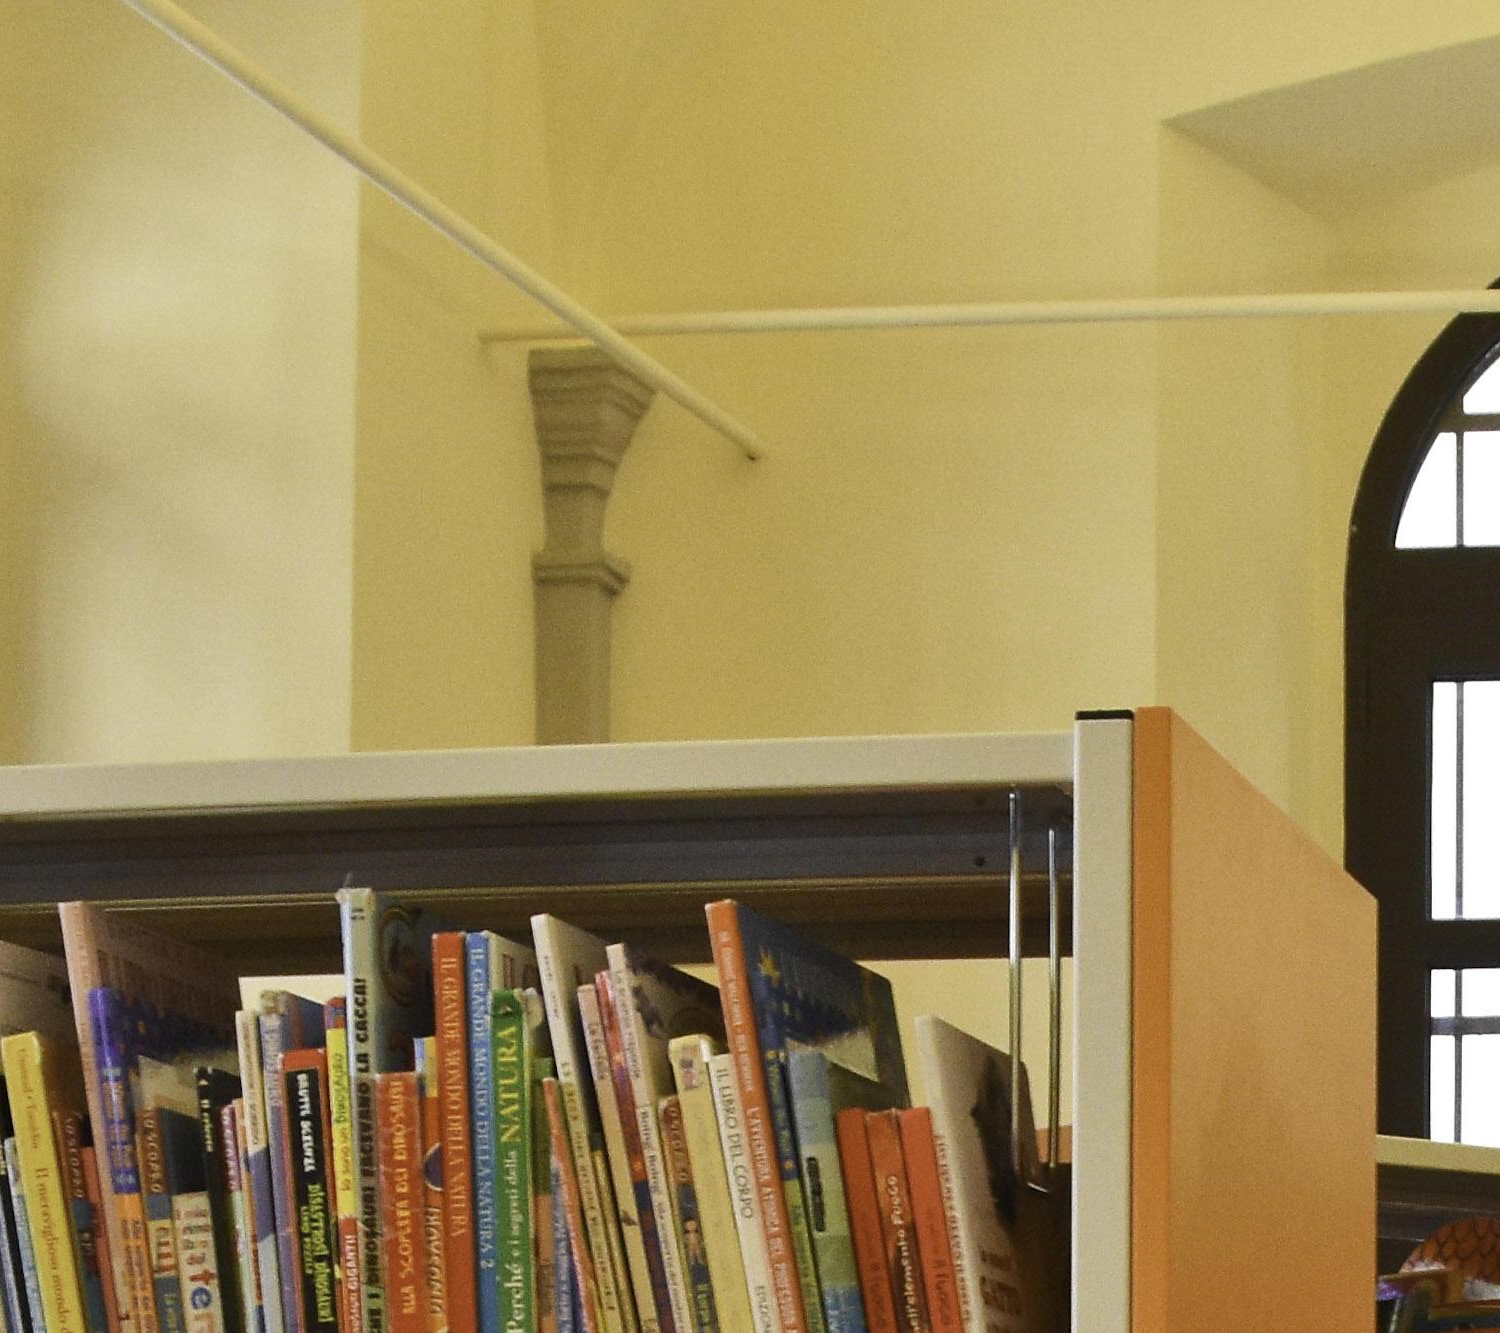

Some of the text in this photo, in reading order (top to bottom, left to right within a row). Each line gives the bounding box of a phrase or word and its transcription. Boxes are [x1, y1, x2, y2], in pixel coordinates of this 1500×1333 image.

[470, 966, 489, 1043] GRANDE
[473, 1048, 491, 1116] MONDO
[497, 1025, 521, 1144] NATURA
[476, 1119, 492, 1177] DELLA
[503, 1150, 518, 1181] della
[715, 1067, 756, 1219] IL LIBRO DEL CORPO
[478, 1180, 495, 1253] NATURA
[505, 1186, 523, 1235] segreti
